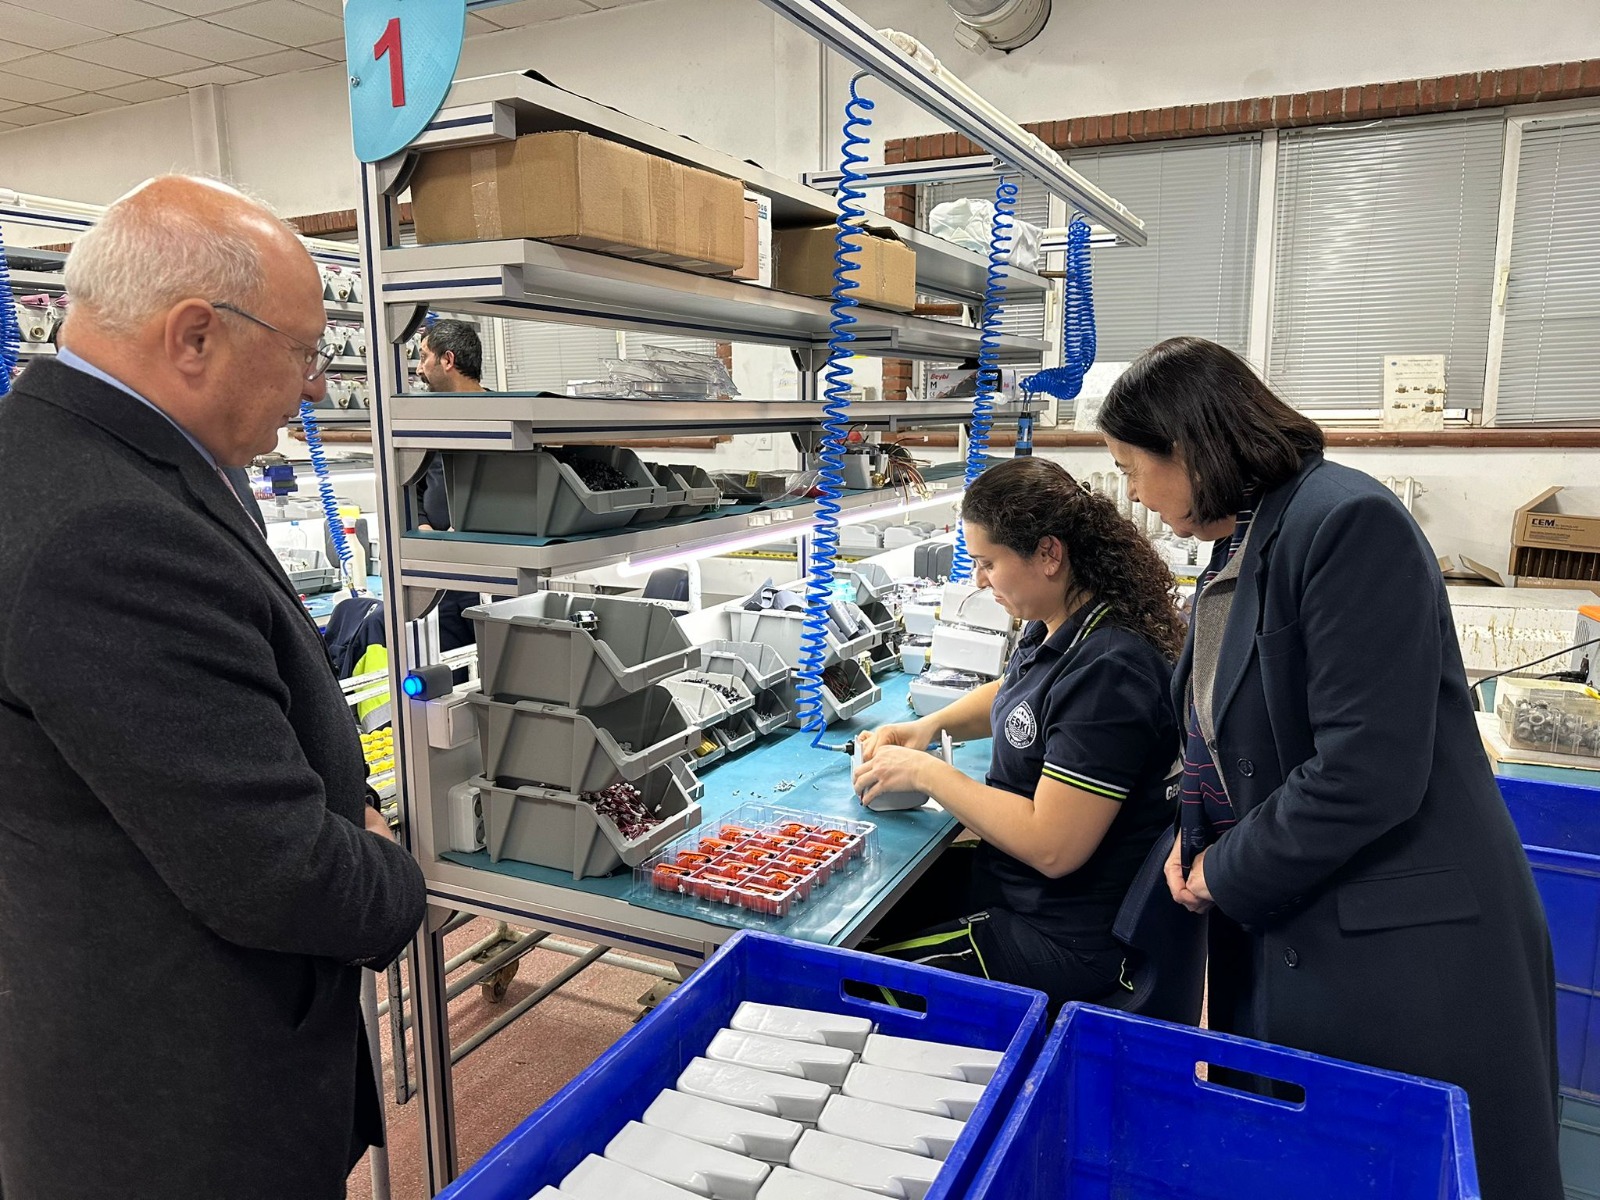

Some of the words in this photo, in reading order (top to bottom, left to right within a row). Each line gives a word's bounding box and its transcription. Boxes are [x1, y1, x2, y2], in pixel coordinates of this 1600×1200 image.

[373, 17, 405, 107] 1
[930, 381, 937, 389] M
[1531, 518, 1556, 527] CEM
